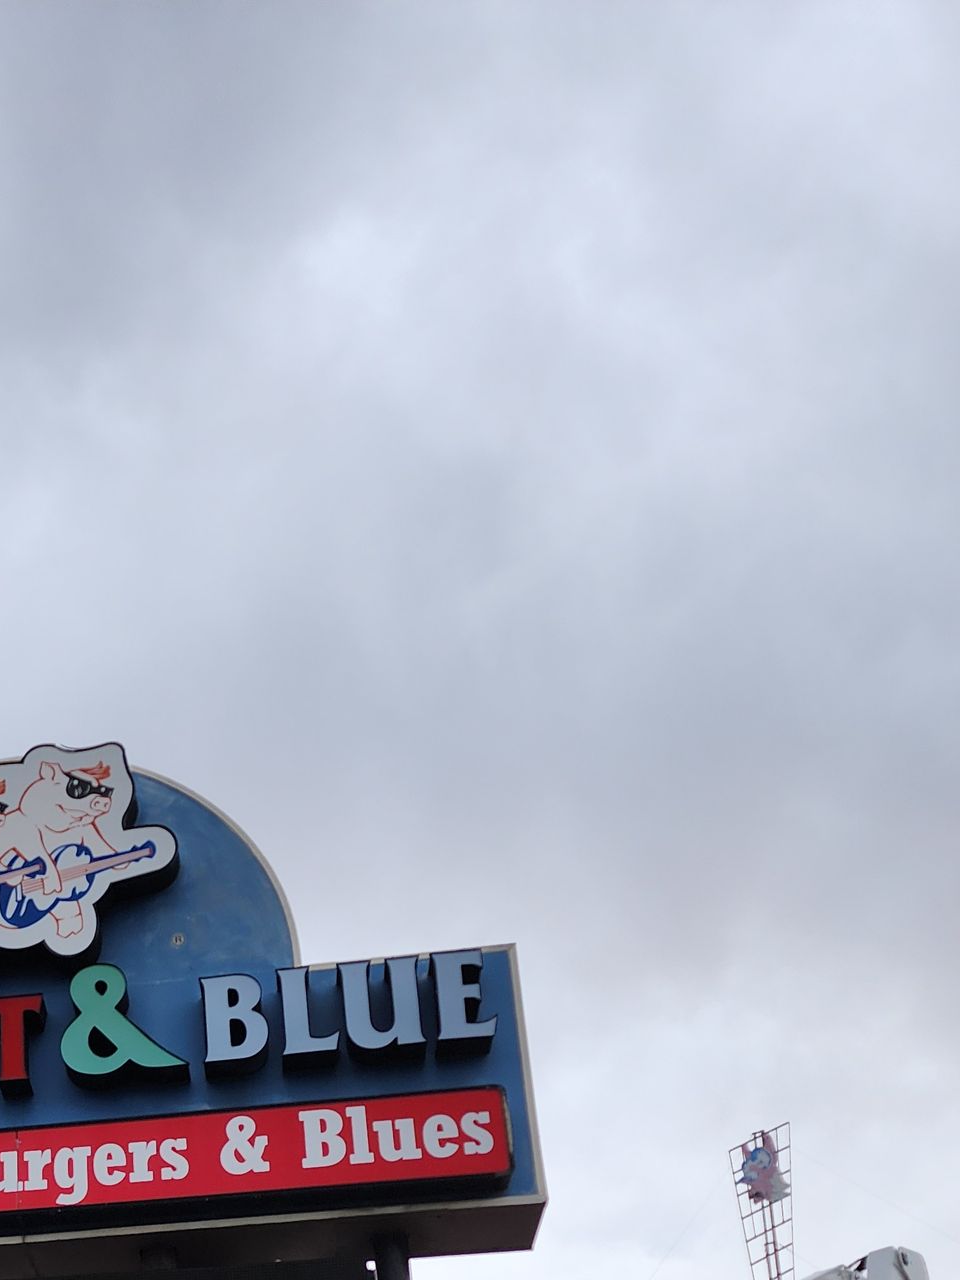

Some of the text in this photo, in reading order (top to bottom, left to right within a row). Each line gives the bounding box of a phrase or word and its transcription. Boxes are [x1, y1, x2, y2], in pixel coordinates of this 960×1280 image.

[60, 964, 188, 1075] &
[200, 949, 498, 1063] BLUE
[220, 1115, 270, 1176] &
[299, 1106, 494, 1169] Blues
